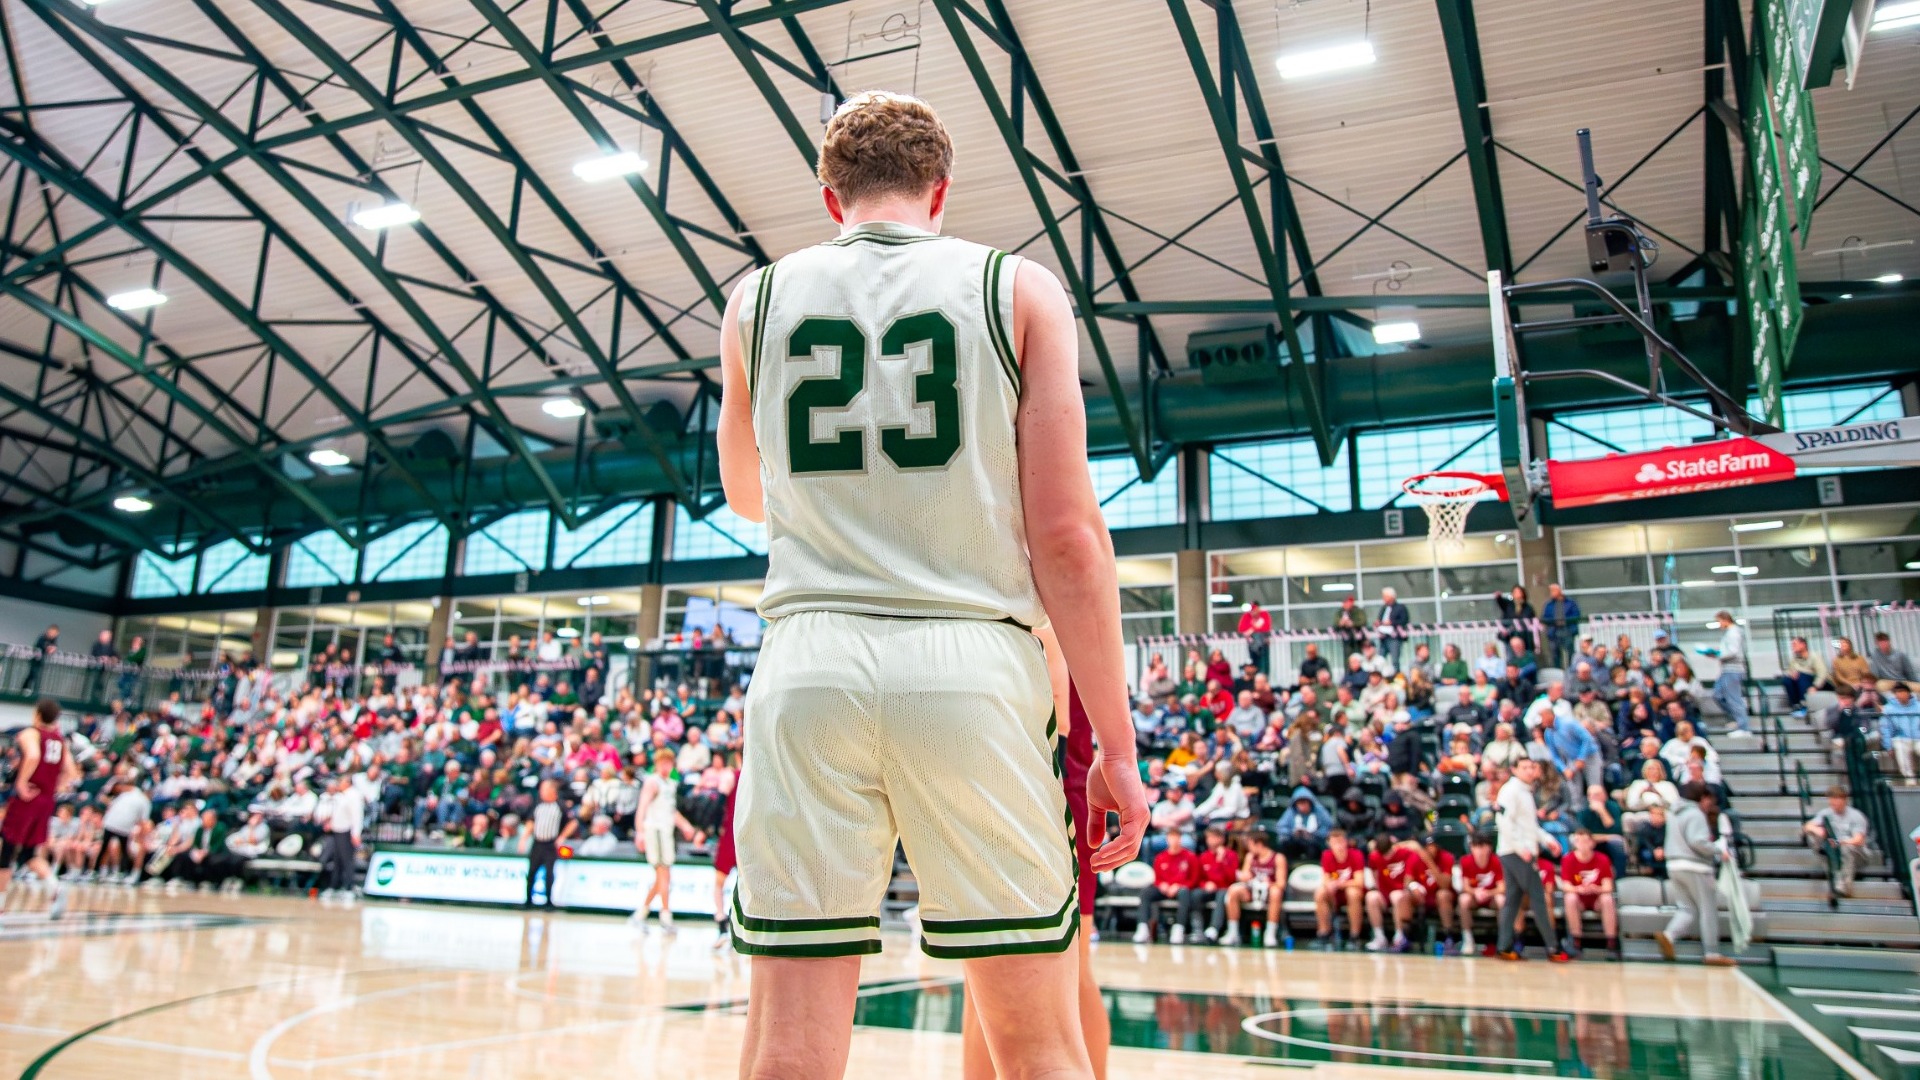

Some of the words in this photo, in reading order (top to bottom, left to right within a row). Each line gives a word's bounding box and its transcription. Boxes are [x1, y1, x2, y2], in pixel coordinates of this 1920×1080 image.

[785, 308, 965, 479] 23
[1795, 422, 1900, 450] SPALDING
[1823, 480, 1835, 499] F
